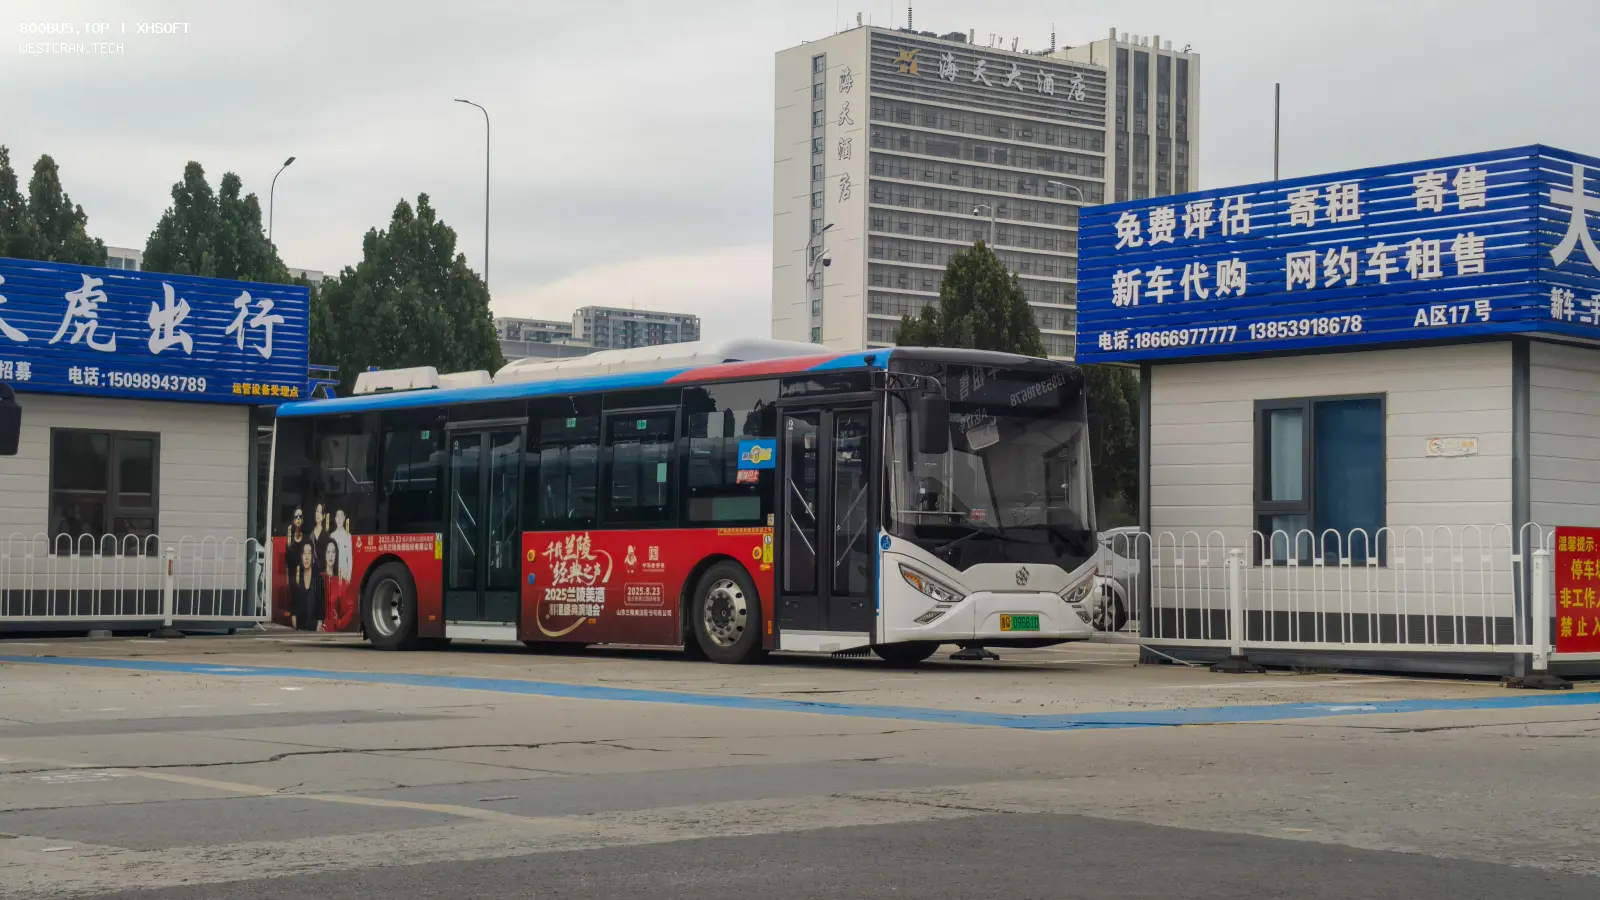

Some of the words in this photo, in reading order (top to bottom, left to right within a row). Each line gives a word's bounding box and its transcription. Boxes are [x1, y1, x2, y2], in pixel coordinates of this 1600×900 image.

[939, 52, 1086, 101] 海天大酒店
[838, 66, 854, 203] 海天酒店
[1114, 198, 1252, 250] 免费评估
[1286, 183, 1361, 228] 寄租
[1411, 166, 1488, 214] 寄售
[1111, 258, 1247, 309] 新车代购
[1286, 231, 1486, 291] 网约车租售
[1098, 325, 1237, 352] 电话:18666977777
[1248, 315, 1362, 339] 13853918678
[1414, 299, 1492, 328] A区17号
[68, 366, 207, 393] 电话:15098943789
[1558, 536, 1598, 552] 温馨提示:
[545, 586, 605, 603] 2025兰陵美酒
[627, 587, 661, 596] 2025.8.23
